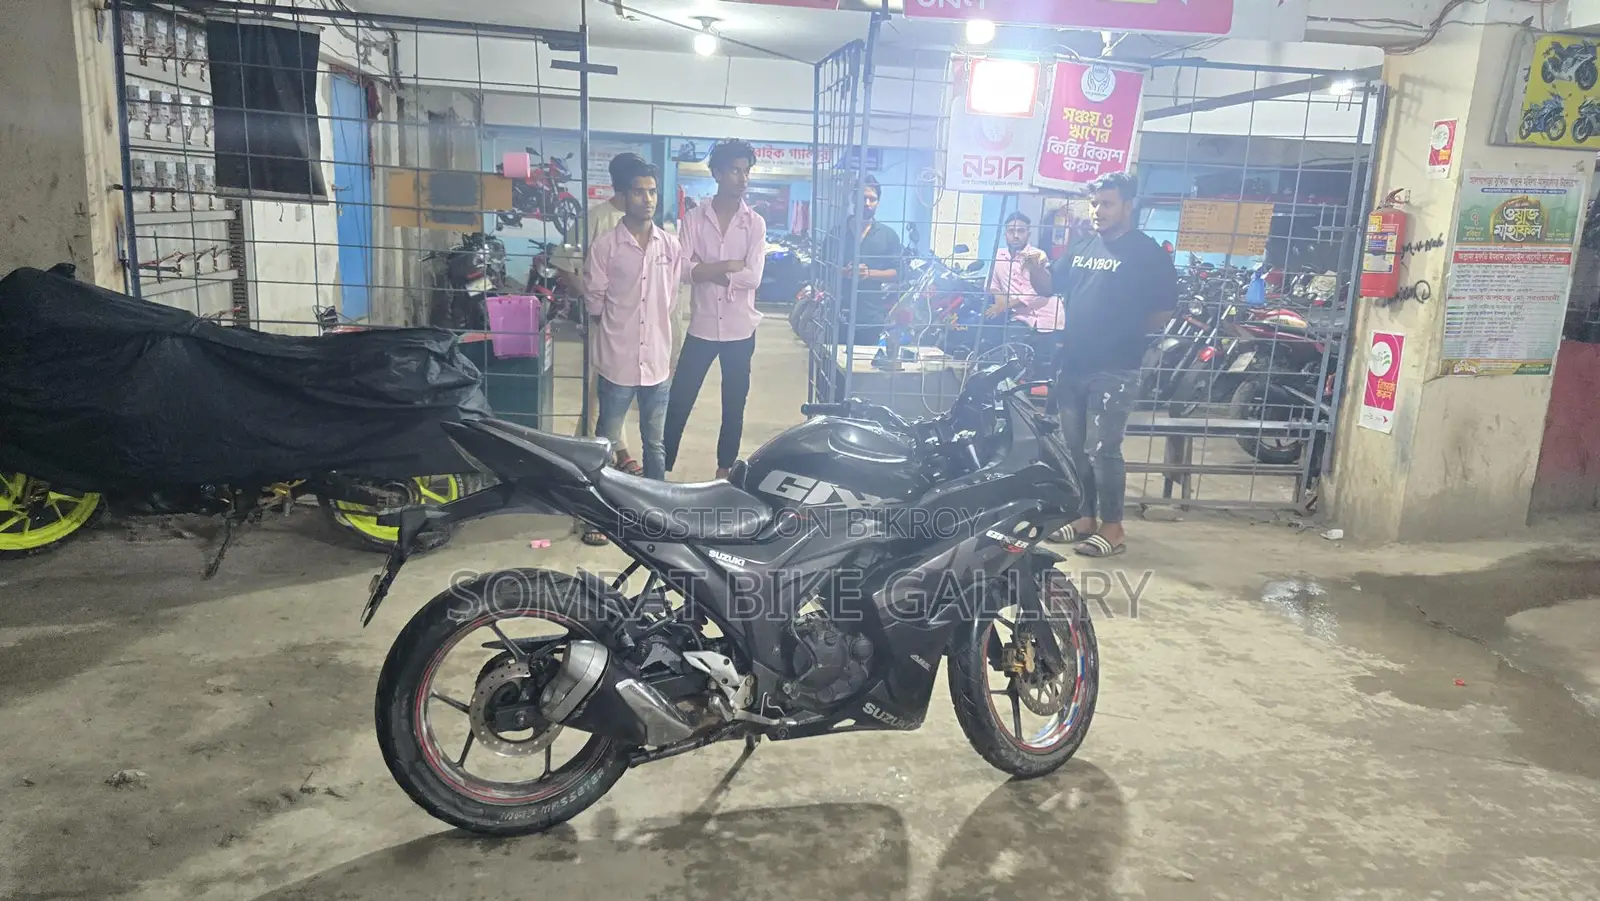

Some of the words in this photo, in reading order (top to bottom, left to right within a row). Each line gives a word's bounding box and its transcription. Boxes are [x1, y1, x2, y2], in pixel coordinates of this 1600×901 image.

[1063, 107, 1101, 127] সঞ্চয়
[1103, 114, 1113, 128] ও
[1083, 141, 1125, 163] বিকাশ
[962, 154, 1025, 181] নগদ
[1063, 157, 1101, 174] করুন
[1072, 255, 1122, 272] PLAYBOY
[708, 549, 746, 567] SUZUKI
